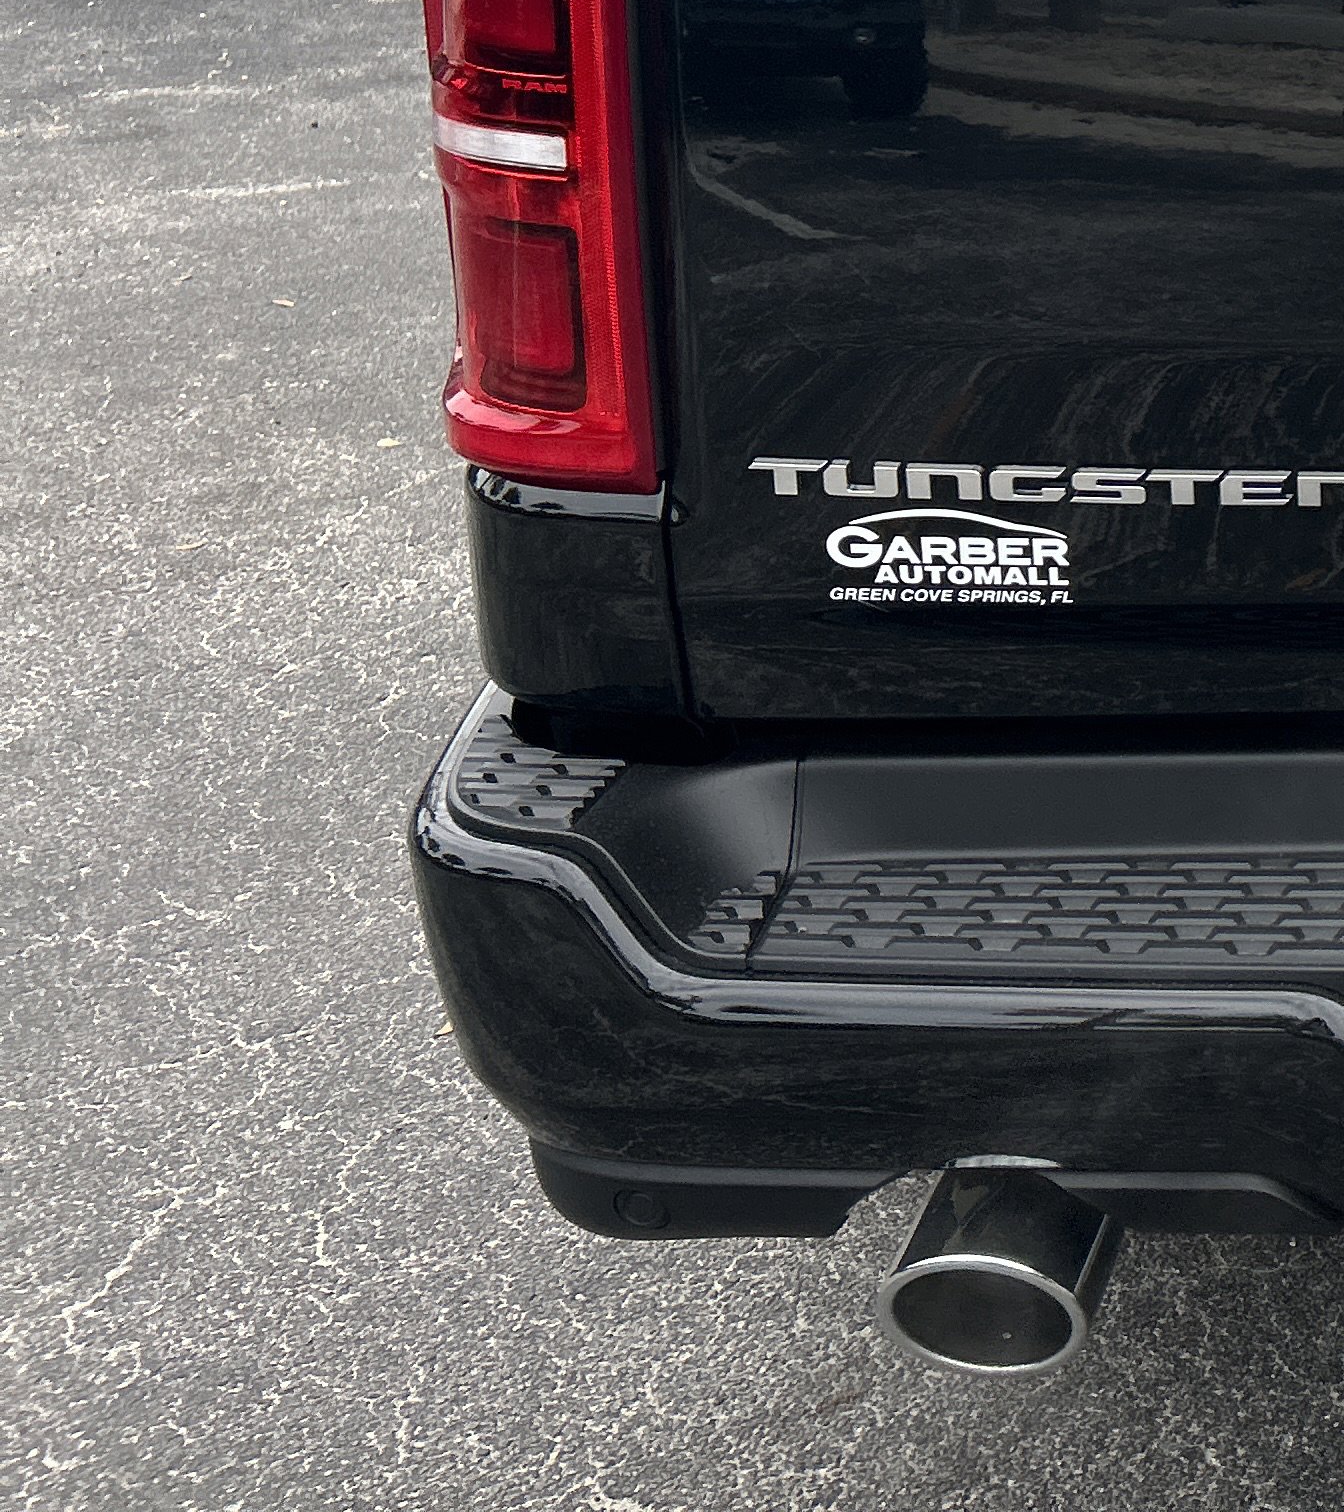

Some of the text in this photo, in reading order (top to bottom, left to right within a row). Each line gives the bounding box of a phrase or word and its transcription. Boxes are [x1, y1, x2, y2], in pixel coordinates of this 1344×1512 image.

[826, 526, 1070, 568] GARBER
[874, 564, 1070, 586] AUTOMALL
[829, 587, 1074, 606] GREEN COVE SPRINGS, FL
